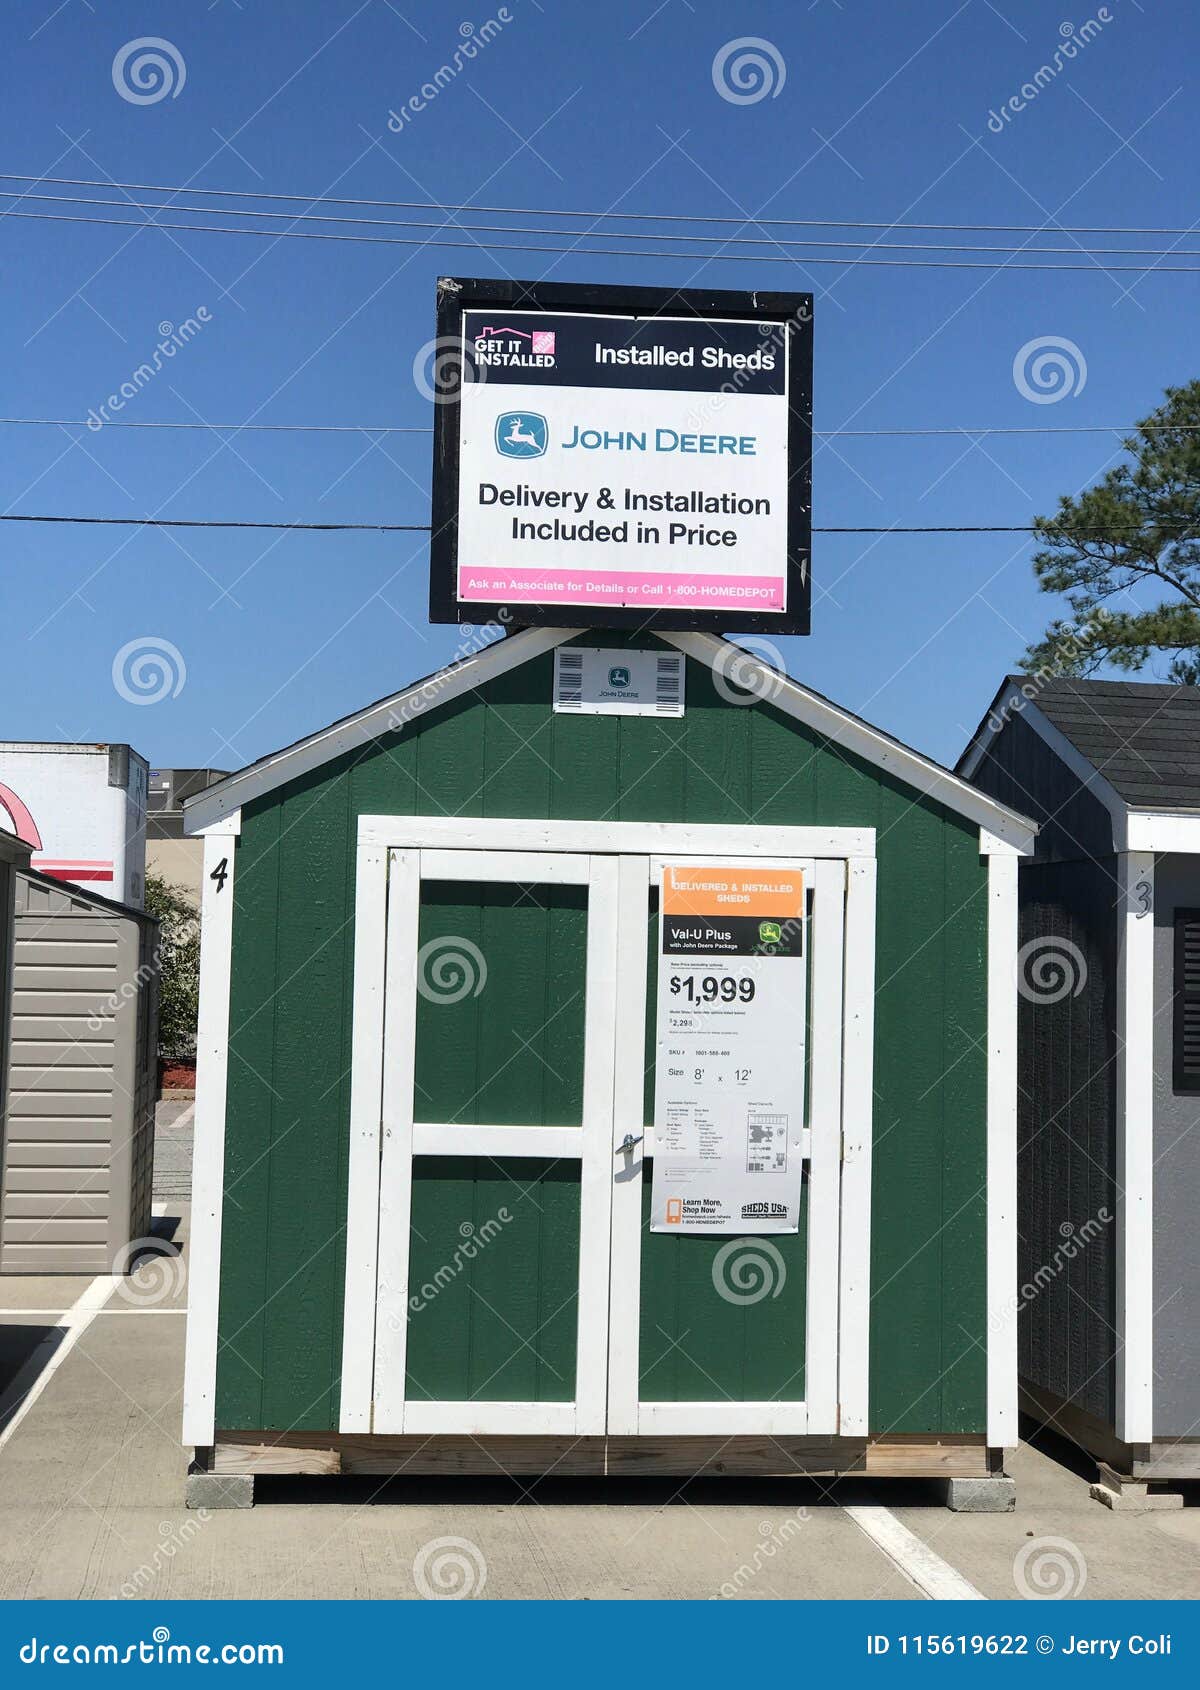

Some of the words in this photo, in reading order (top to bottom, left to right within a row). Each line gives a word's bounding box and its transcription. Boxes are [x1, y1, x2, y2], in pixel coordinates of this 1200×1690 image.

[474, 339, 504, 353] GET
[508, 340, 522, 353] IT
[595, 343, 694, 367] Installed
[701, 347, 775, 371] Sheds
[561, 425, 647, 452] JOHN
[655, 427, 757, 456] DEERE
[478, 483, 588, 513] Delivery
[596, 487, 616, 510] &
[624, 488, 771, 516] Installation
[511, 517, 628, 544] Included
[637, 521, 660, 544] in
[669, 522, 738, 547] Price
[468, 579, 489, 590] Ask
[492, 581, 506, 590] an
[510, 580, 564, 592] Associate
[567, 581, 582, 592] for
[586, 582, 624, 594] Details
[627, 585, 639, 594] or
[642, 583, 664, 595] Call
[667, 585, 777, 599] 1-800-HOMEDEPOT
[599, 690, 617, 698] JOHN
[618, 690, 640, 699] DEERE
[209, 857, 228, 894] 4
[673, 881, 728, 893] DELIVERED
[731, 883, 738, 893] &
[742, 883, 794, 894] INSTALLED
[716, 894, 751, 904] SHEDS
[1135, 880, 1153, 920] 3
[671, 927, 702, 940] Val-U
[705, 929, 732, 941] Plus
[669, 941, 682, 949] with
[682, 941, 697, 950] John
[697, 942, 714, 950] Deere
[714, 943, 738, 951] Package
[669, 975, 756, 1007] $1,999
[668, 1067, 684, 1076] Size
[694, 1068, 705, 1080] 8'
[734, 1069, 752, 1081] 12'
[682, 1198, 702, 1206] Learn
[703, 1199, 722, 1208] More,
[741, 1202, 769, 1213] SHEDS
[771, 1202, 788, 1213] USA
[682, 1206, 698, 1215] Shop
[700, 1206, 716, 1214] Now
